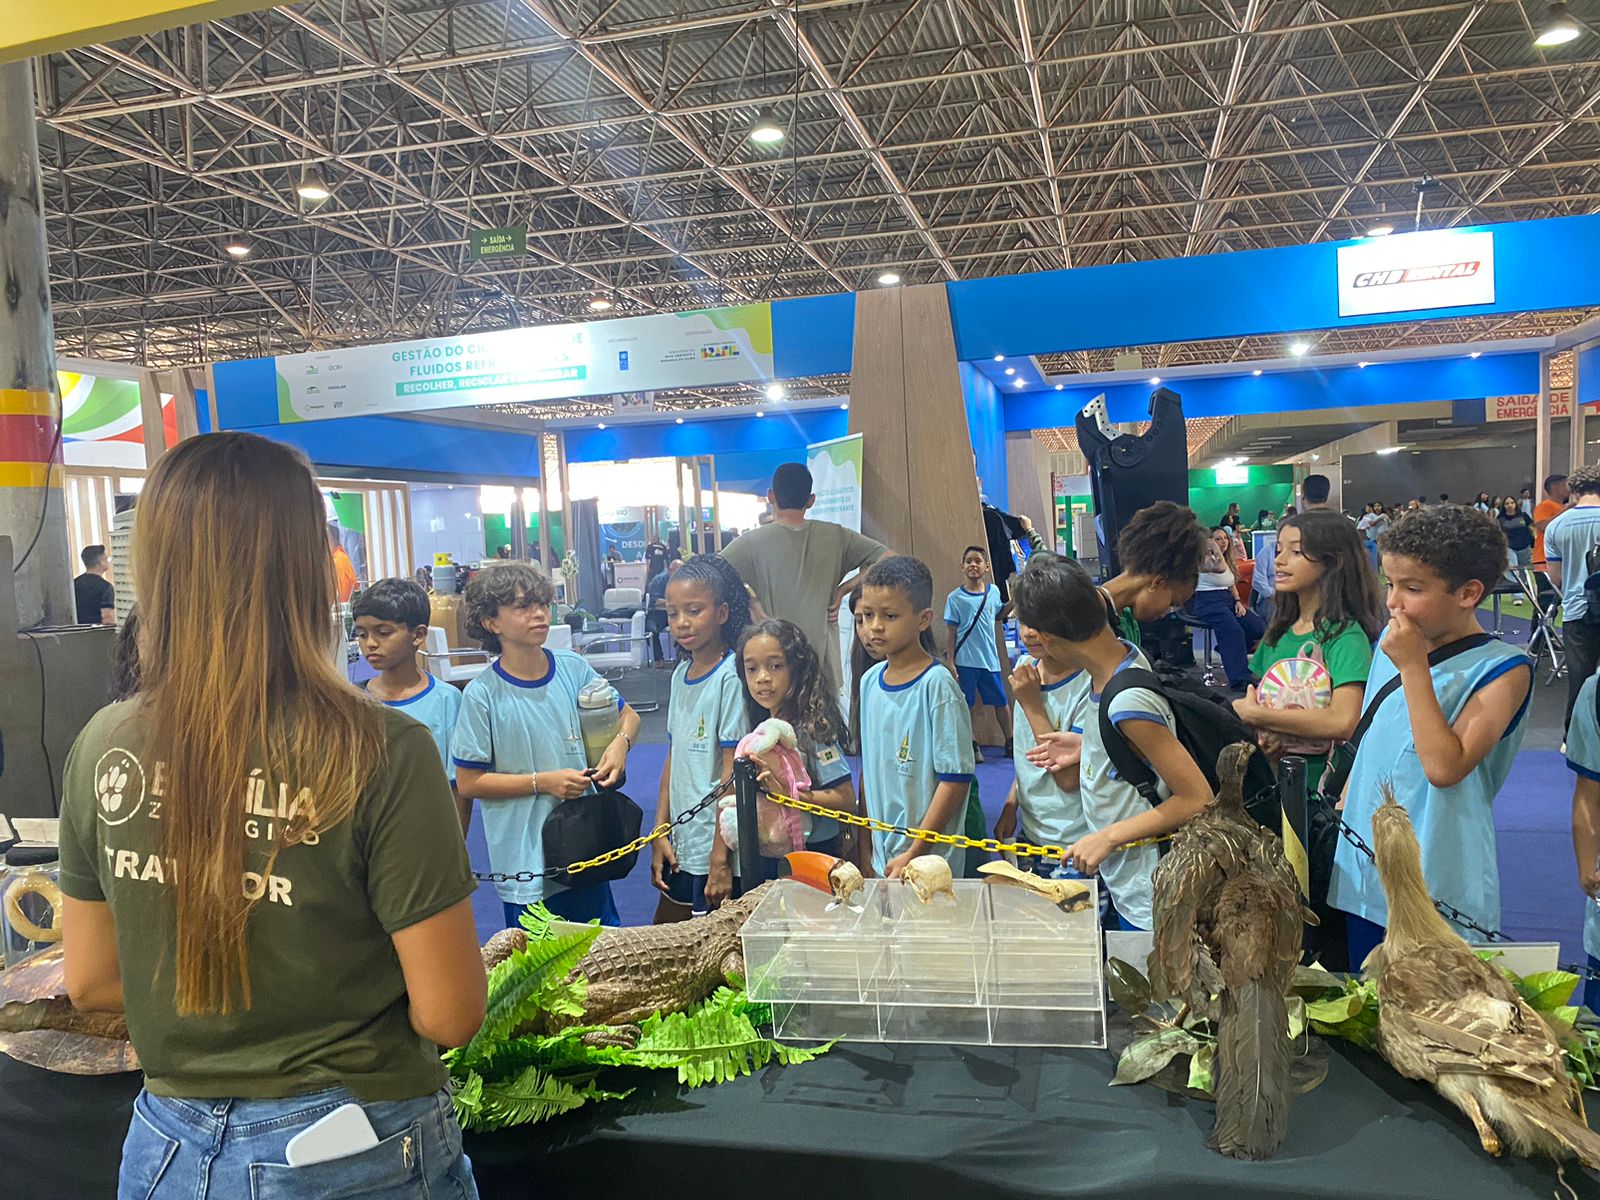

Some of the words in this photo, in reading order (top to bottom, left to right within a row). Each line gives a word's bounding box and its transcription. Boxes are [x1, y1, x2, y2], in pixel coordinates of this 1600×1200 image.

[392, 346, 442, 361] GESTÃO
[445, 345, 464, 357] DO
[410, 361, 462, 376] FLUIDOS
[403, 379, 457, 393] RECOLHER,
[1549, 392, 1570, 403] DE
[1496, 404, 1569, 418] EMERGÊCIA
[104, 844, 293, 907] TRAOR
